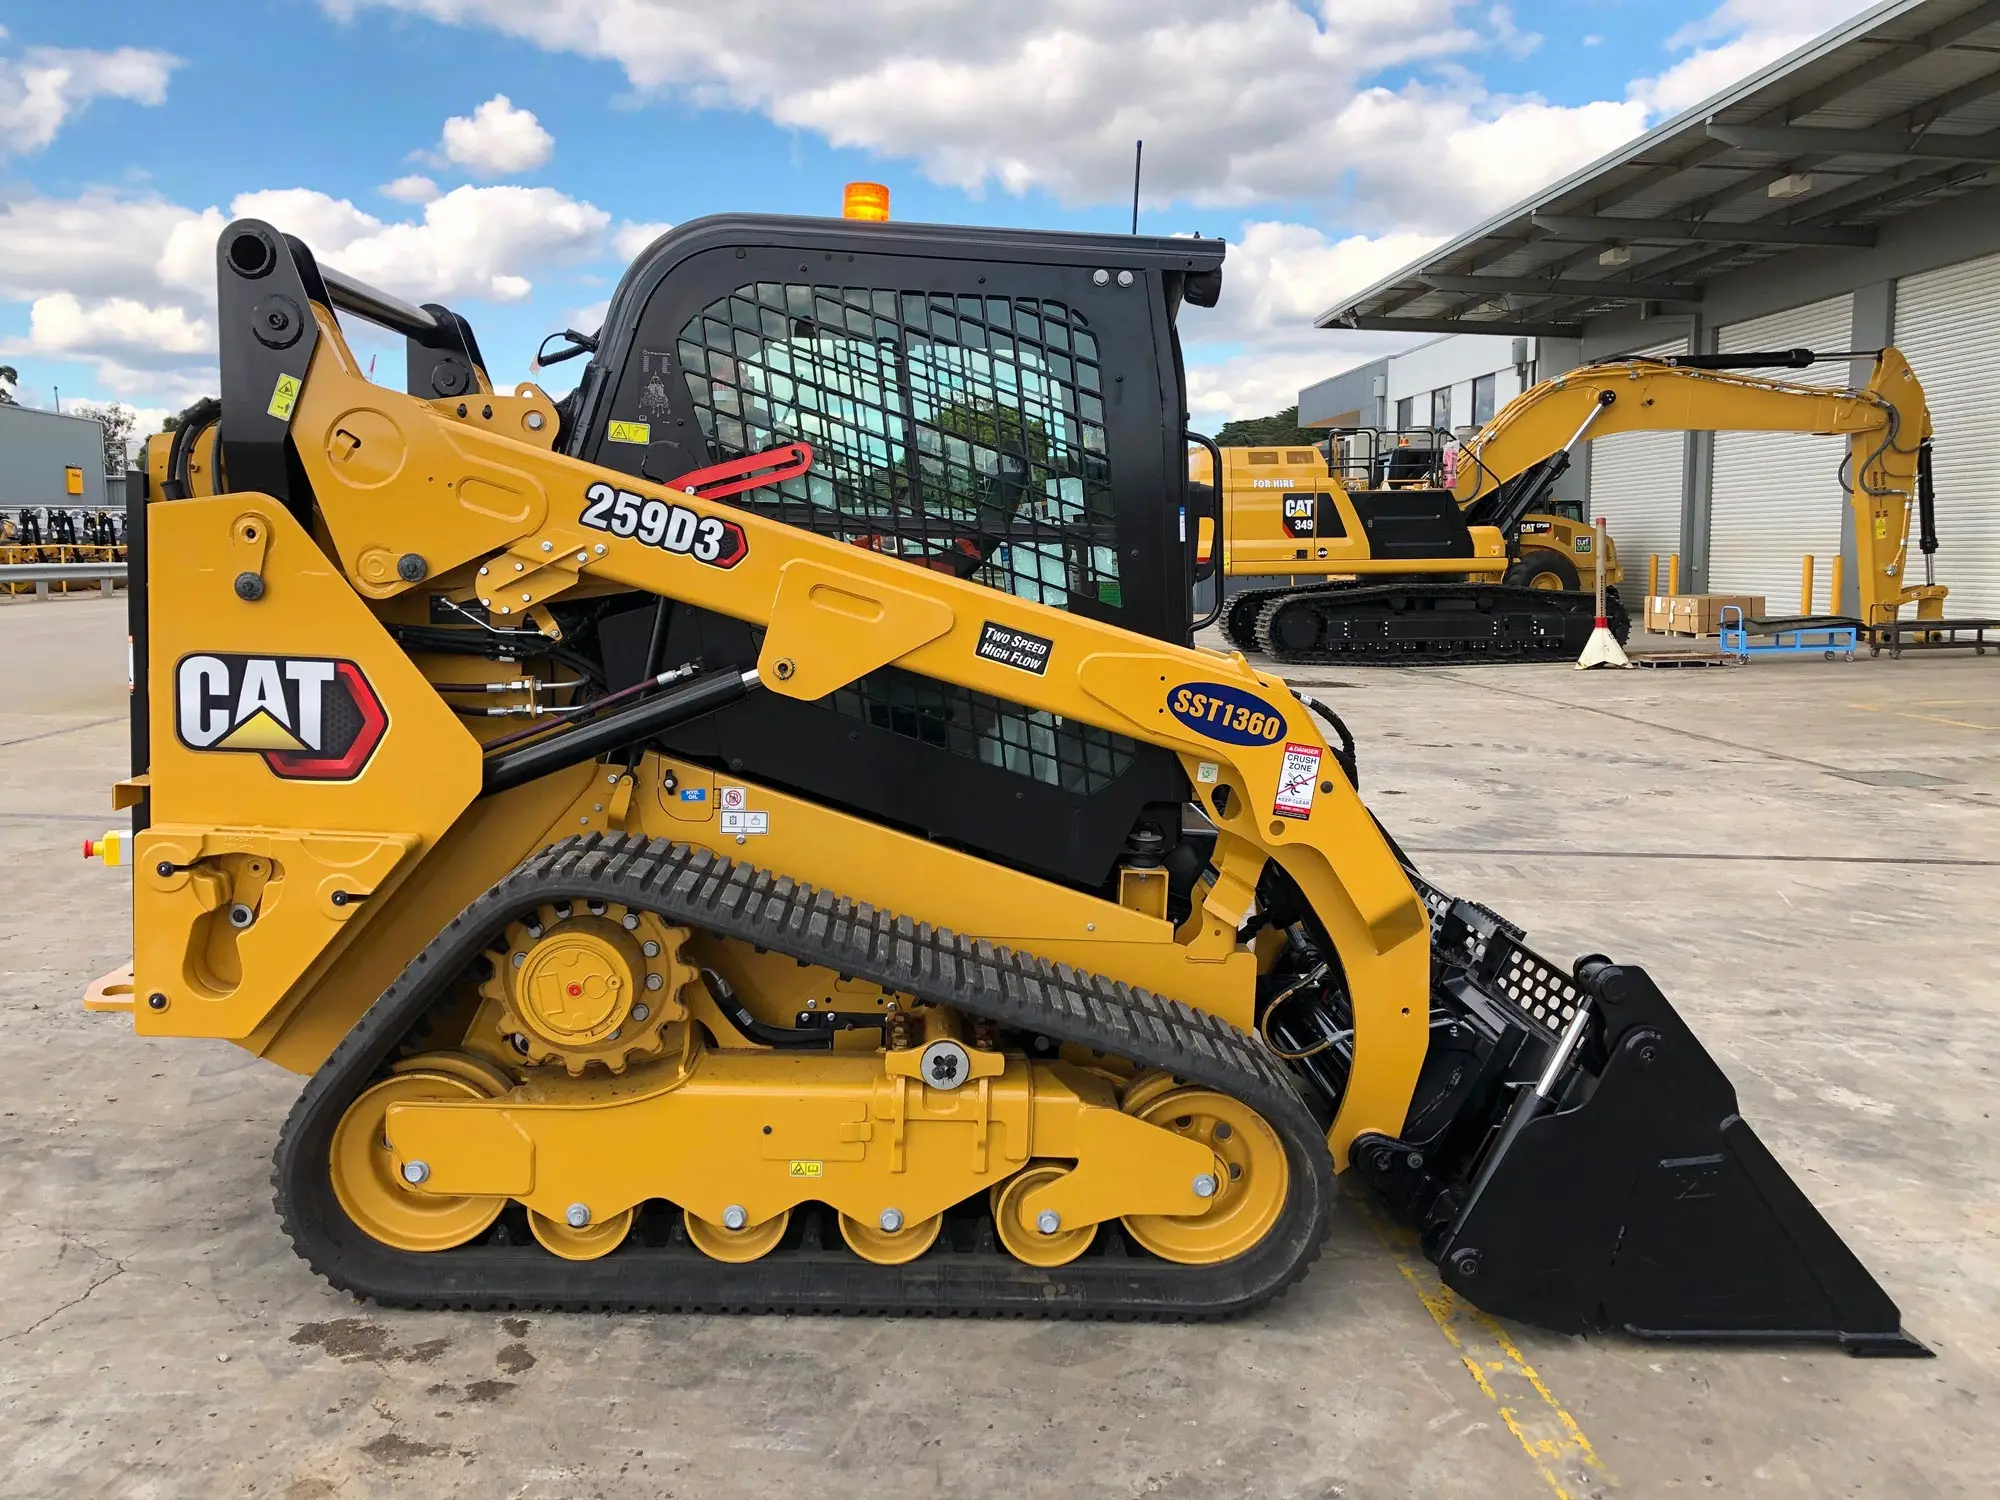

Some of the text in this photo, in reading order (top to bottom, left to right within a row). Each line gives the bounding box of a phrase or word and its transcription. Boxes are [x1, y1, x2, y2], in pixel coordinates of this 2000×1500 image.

[1253, 480, 1294, 488] FOR HIRE
[1285, 499, 1313, 517] CAT
[581, 484, 725, 561] 259D3
[1294, 519, 1313, 530] 349
[1521, 523, 1535, 532] CAT
[179, 656, 334, 750] CAT
[1174, 689, 1280, 740] SST1360
[1294, 746, 1319, 755] DANGER
[1287, 754, 1317, 765] CRUSH
[1289, 762, 1312, 772] ZONE
